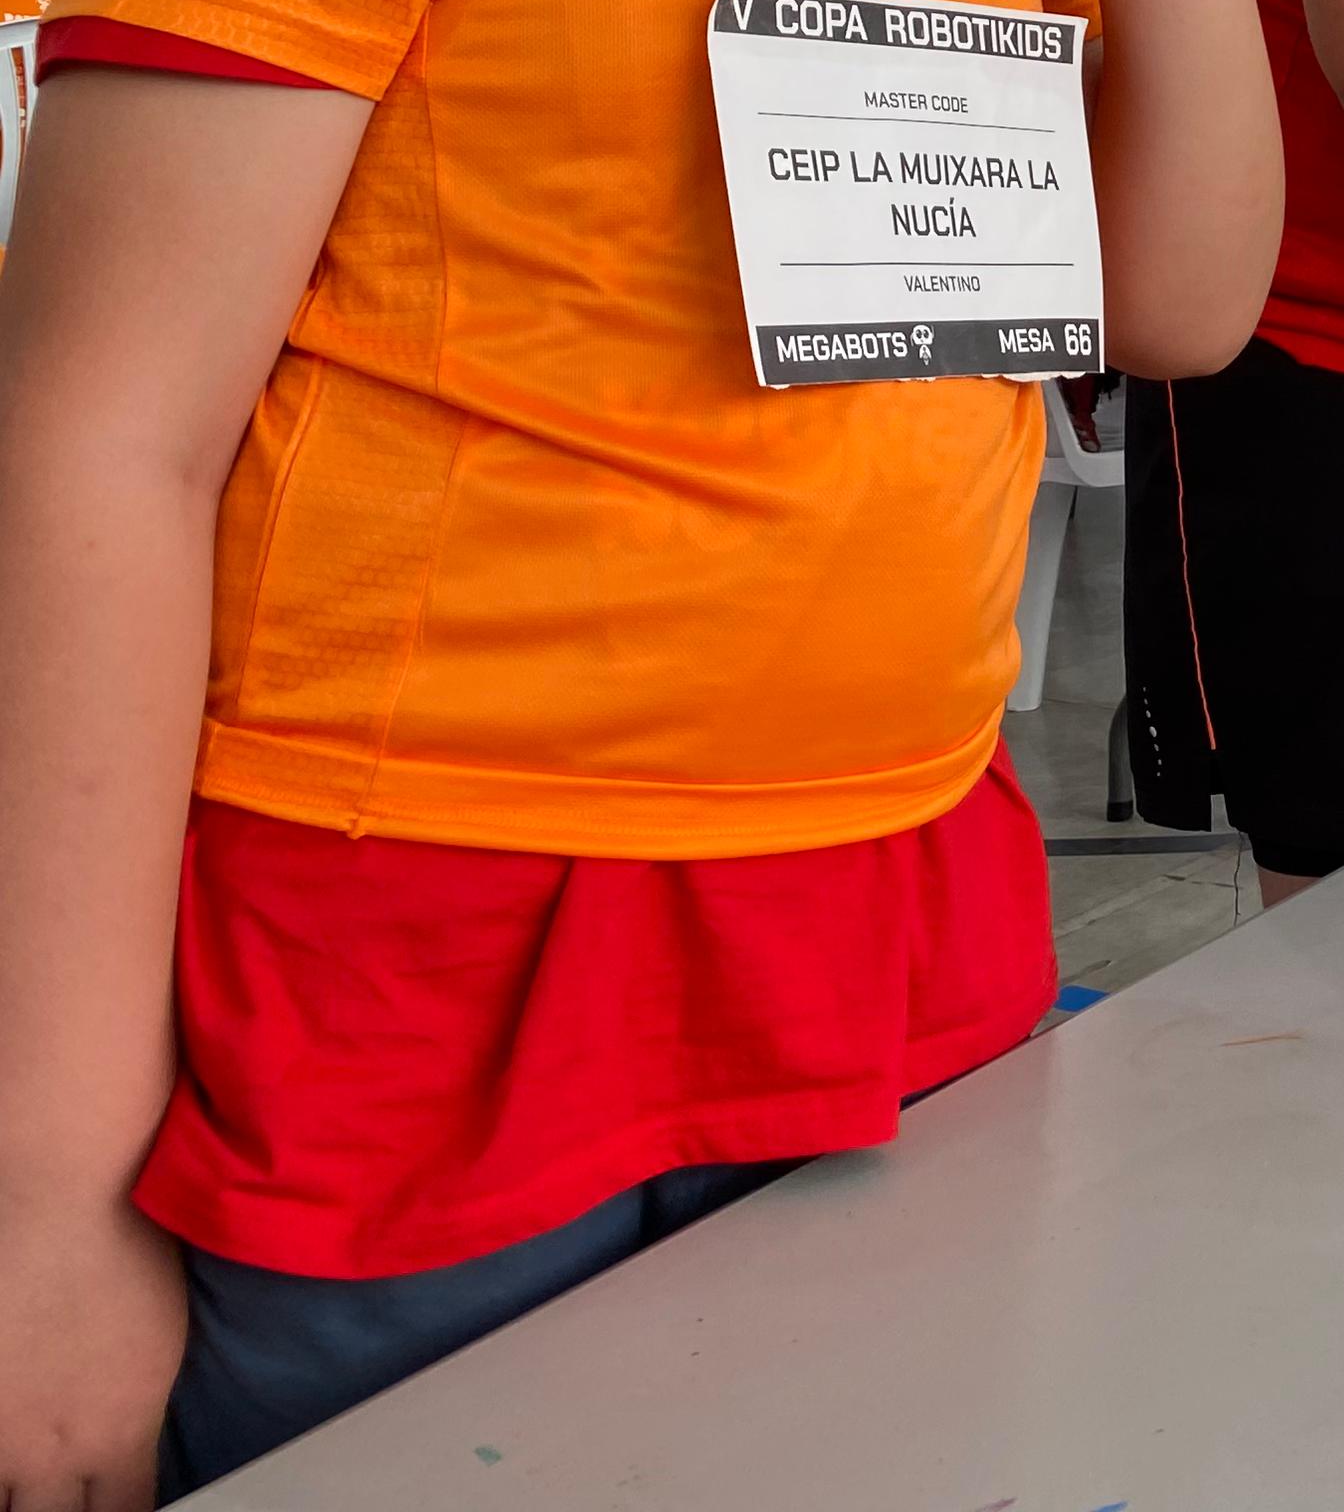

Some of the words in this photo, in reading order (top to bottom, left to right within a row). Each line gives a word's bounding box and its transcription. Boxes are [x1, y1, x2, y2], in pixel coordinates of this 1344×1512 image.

[885, 8, 1063, 60] ROBOTIKIDS
[864, 91, 928, 111] MASTER
[931, 95, 969, 114] CODE
[767, 147, 840, 183] CEIP
[850, 151, 893, 184] LA
[900, 152, 1023, 189] MUIXARA
[1028, 159, 1060, 191] LA
[891, 196, 977, 238] NUCÍA
[904, 274, 981, 293] VALENTINO
[776, 332, 908, 363] MEGABOTS
[999, 328, 1055, 354] MESA
[1064, 323, 1092, 356] 66
